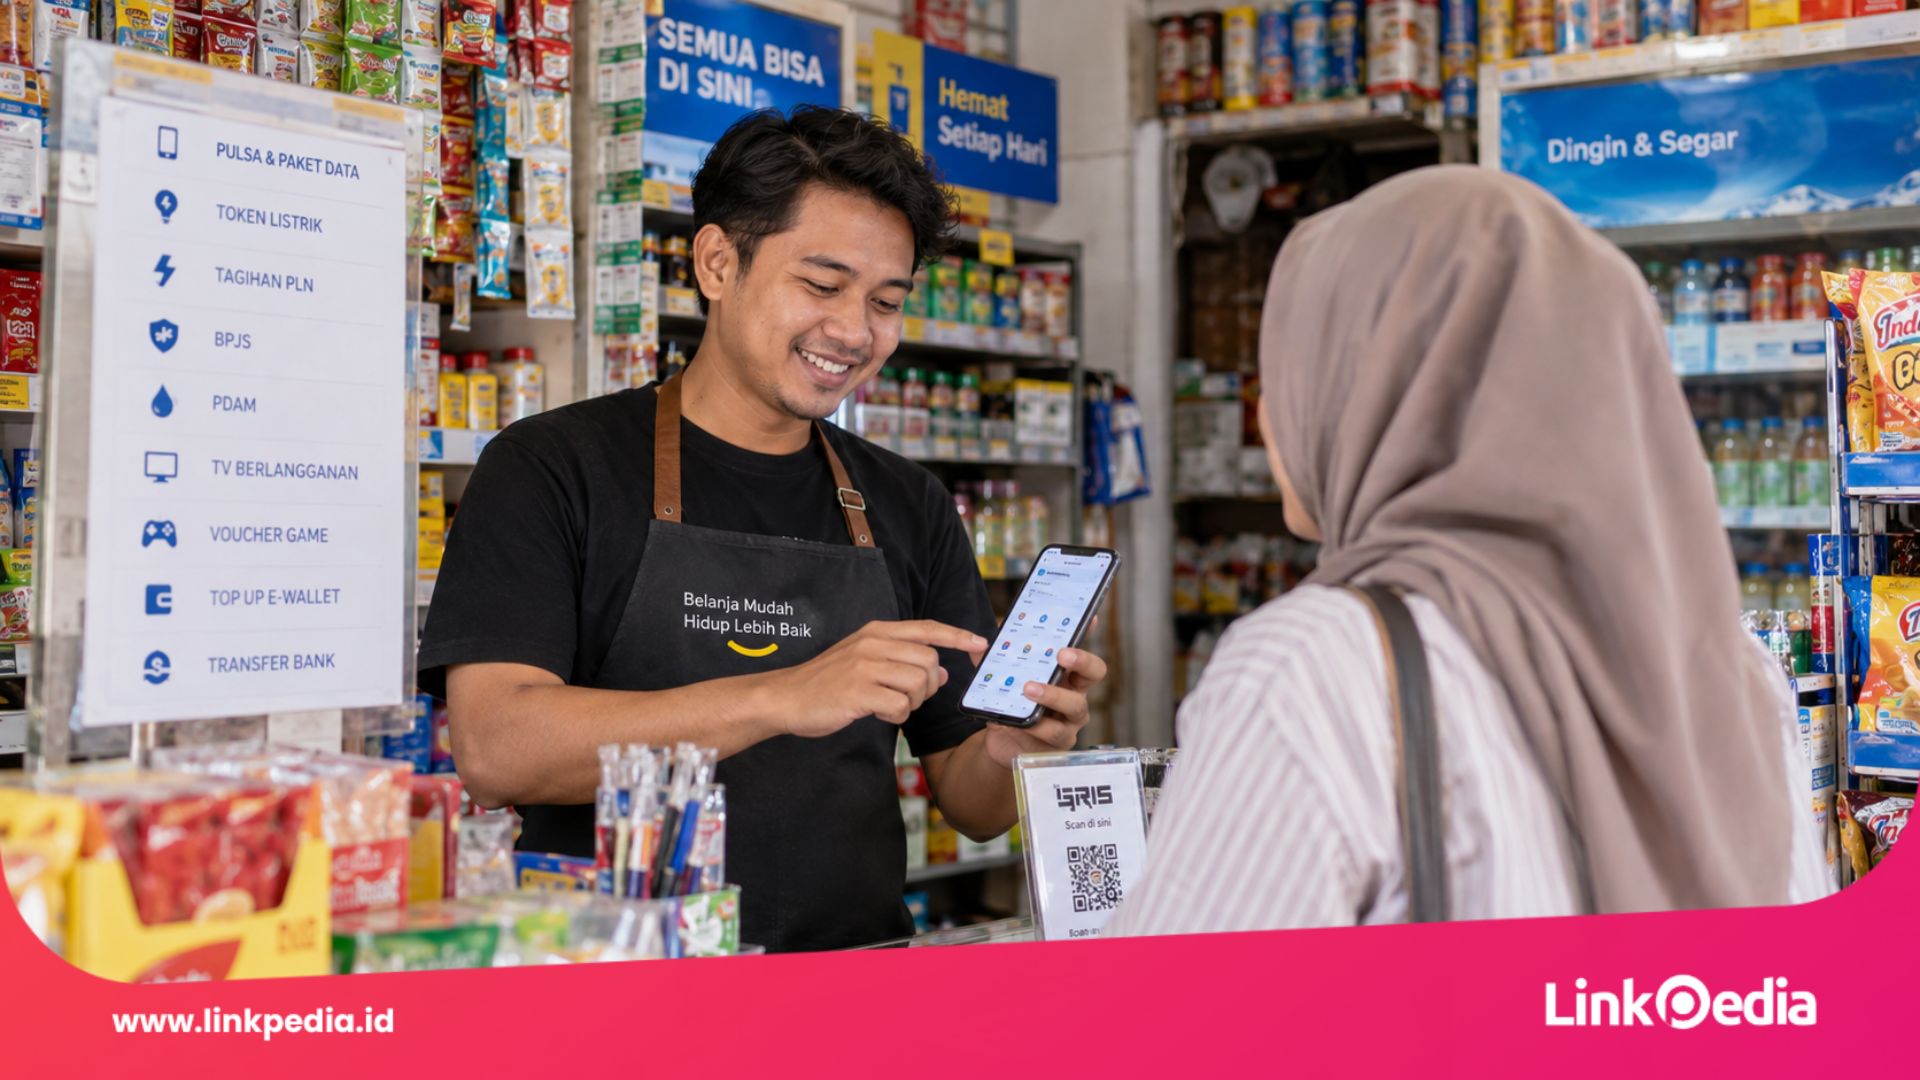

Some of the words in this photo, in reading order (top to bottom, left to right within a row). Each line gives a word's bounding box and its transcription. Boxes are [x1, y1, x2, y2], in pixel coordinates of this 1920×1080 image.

[658, 17, 758, 71] SEMUA
[763, 43, 825, 88] BISA
[659, 56, 689, 95] DI
[697, 66, 753, 109] SINI
[939, 77, 1010, 121] Hemat
[938, 115, 1003, 162] Setiap
[1006, 131, 1048, 167] Hari
[1547, 134, 1628, 165] Dingin
[1633, 132, 1653, 157] &
[1659, 129, 1739, 158] Segar
[216, 142, 262, 164] PULSA
[265, 150, 275, 166] &
[278, 152, 322, 174] PAKET
[325, 160, 361, 180] DATA
[216, 204, 267, 226] TOKEN
[270, 212, 323, 233] LISTRIK
[215, 267, 282, 289] TAGIHAN
[286, 275, 314, 293] PLN
[214, 331, 252, 350] BPJS
[212, 395, 257, 413] PDAM
[211, 459, 232, 476] TV
[235, 460, 359, 481] BERLANGGANAN
[209, 526, 283, 543] VOUCHER
[286, 527, 329, 544] GAME
[210, 590, 241, 606] TOP
[244, 589, 265, 606] UP
[268, 588, 341, 605] E-WALLET
[684, 592, 740, 613] Belanja
[744, 599, 794, 616] Mudah
[684, 614, 730, 634] Hidup
[735, 618, 776, 636] Lebih
[780, 622, 812, 638] Baik
[208, 654, 289, 674] TRANSFER
[293, 652, 336, 670] BANK
[1065, 820, 1086, 830] Scan
[1087, 818, 1096, 829] di
[1097, 817, 1112, 828] sini
